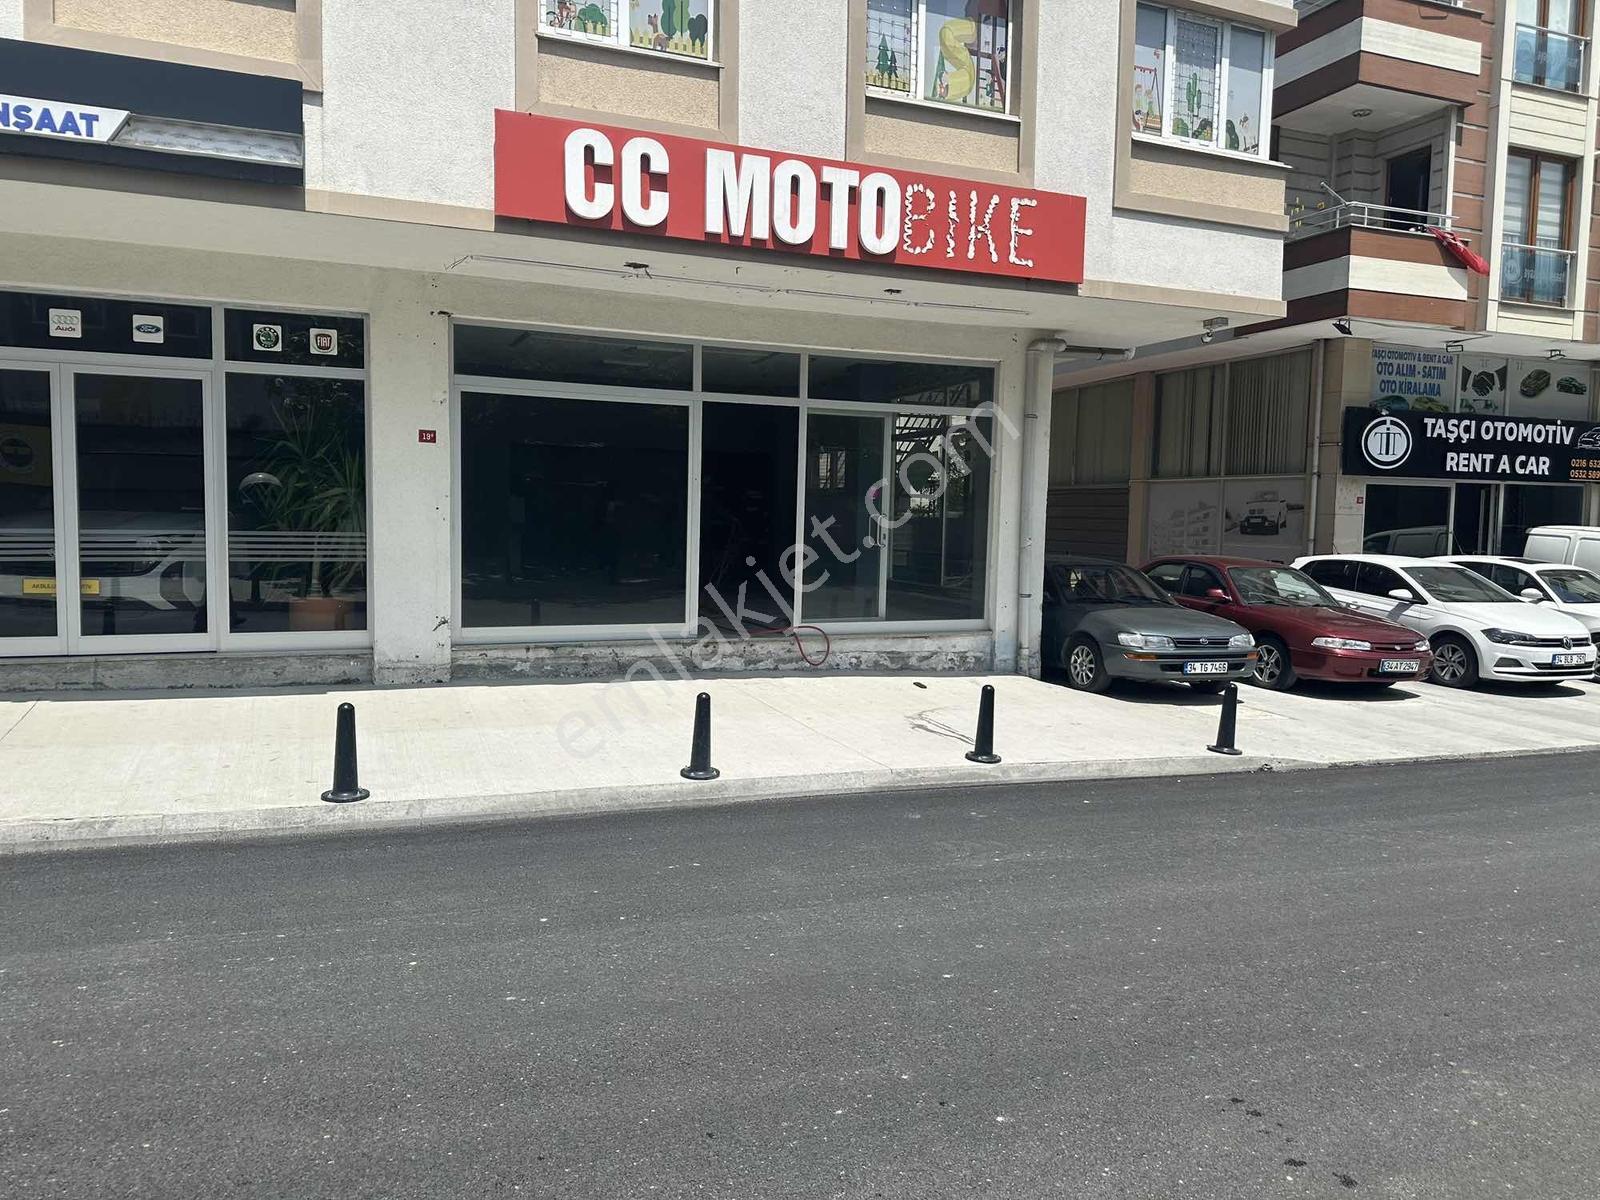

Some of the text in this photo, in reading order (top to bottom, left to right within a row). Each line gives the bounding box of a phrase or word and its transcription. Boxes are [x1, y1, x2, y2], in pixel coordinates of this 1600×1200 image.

[564, 128, 669, 227] CC
[317, 335, 331, 347] FIAT
[1423, 353, 1437, 363] RENT
[1442, 355, 1454, 365] CAR
[1376, 362, 1394, 376] OTO
[1395, 363, 1416, 378] ALIM
[1422, 365, 1446, 380] SATIM
[1379, 378, 1441, 397] OTO KİRALAMA
[1423, 417, 1575, 445] TAŞÇI OTOMOTİV
[1445, 452, 1550, 476] RENT A CAR
[1188, 663, 1196, 672] 34
[1200, 663, 1208, 672] TG
